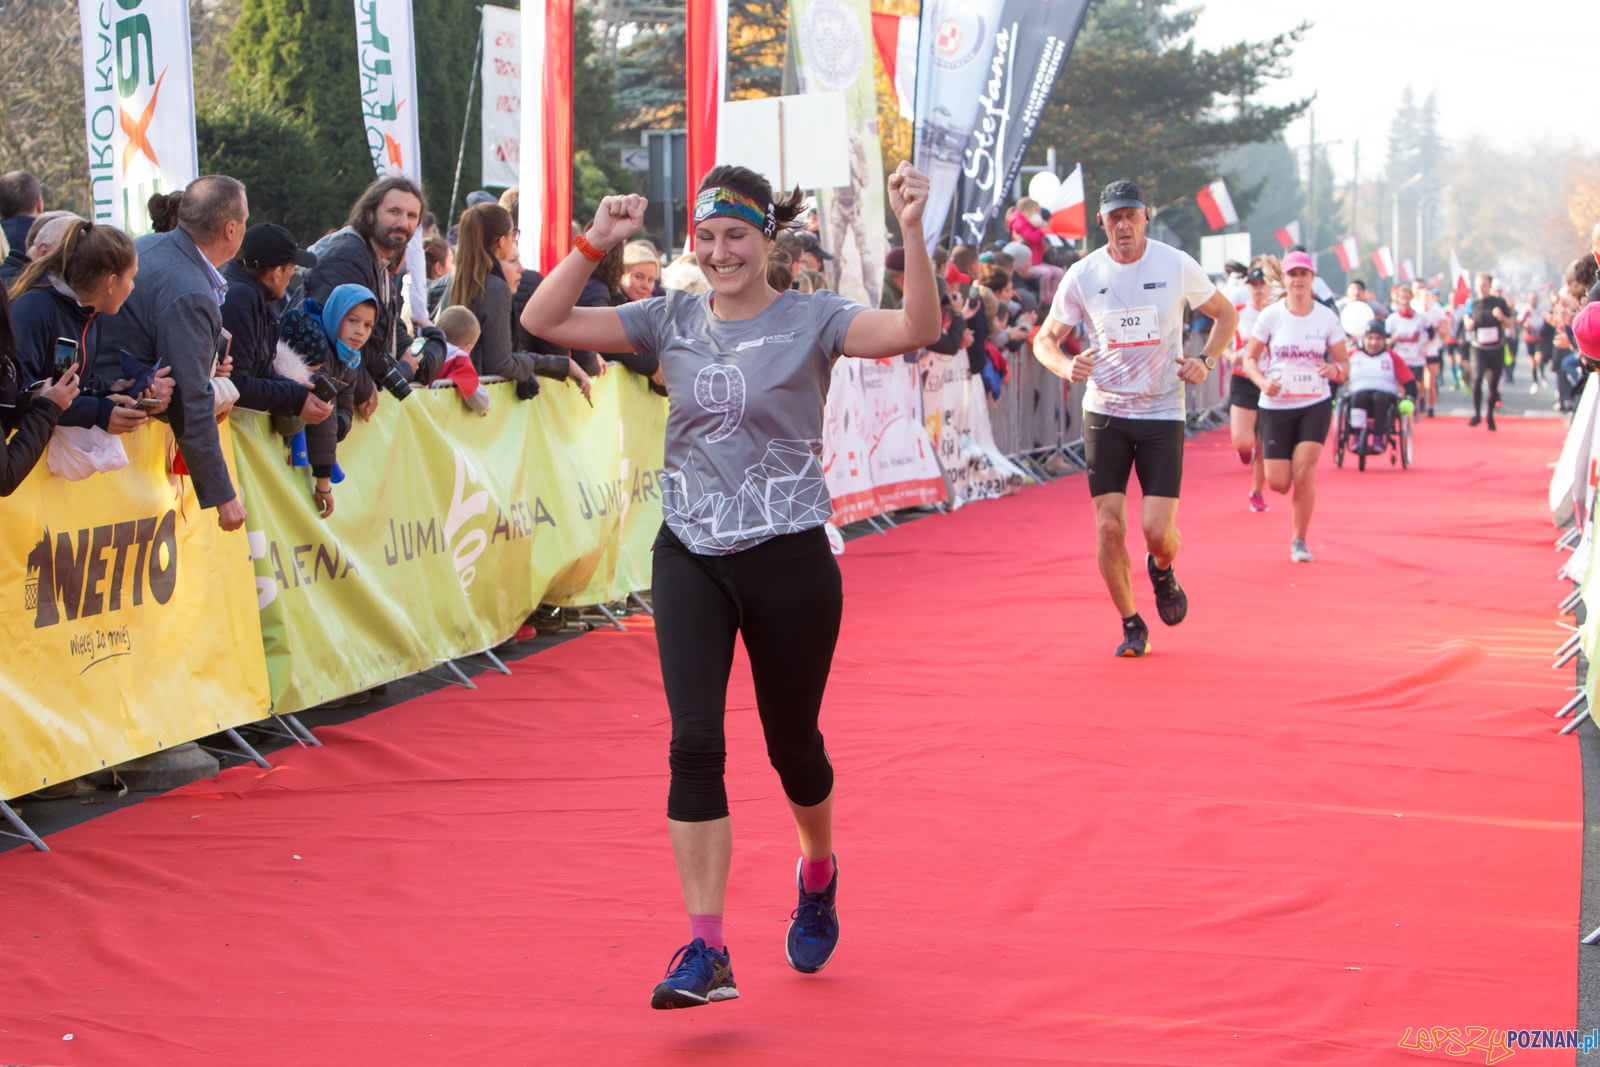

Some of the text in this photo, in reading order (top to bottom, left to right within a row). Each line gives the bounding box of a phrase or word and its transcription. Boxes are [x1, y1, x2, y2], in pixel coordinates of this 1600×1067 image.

[962, 27, 1011, 191] Stefana
[1119, 316, 1141, 327] 202
[694, 363, 746, 444] 9
[54, 509, 178, 623] NETTO
